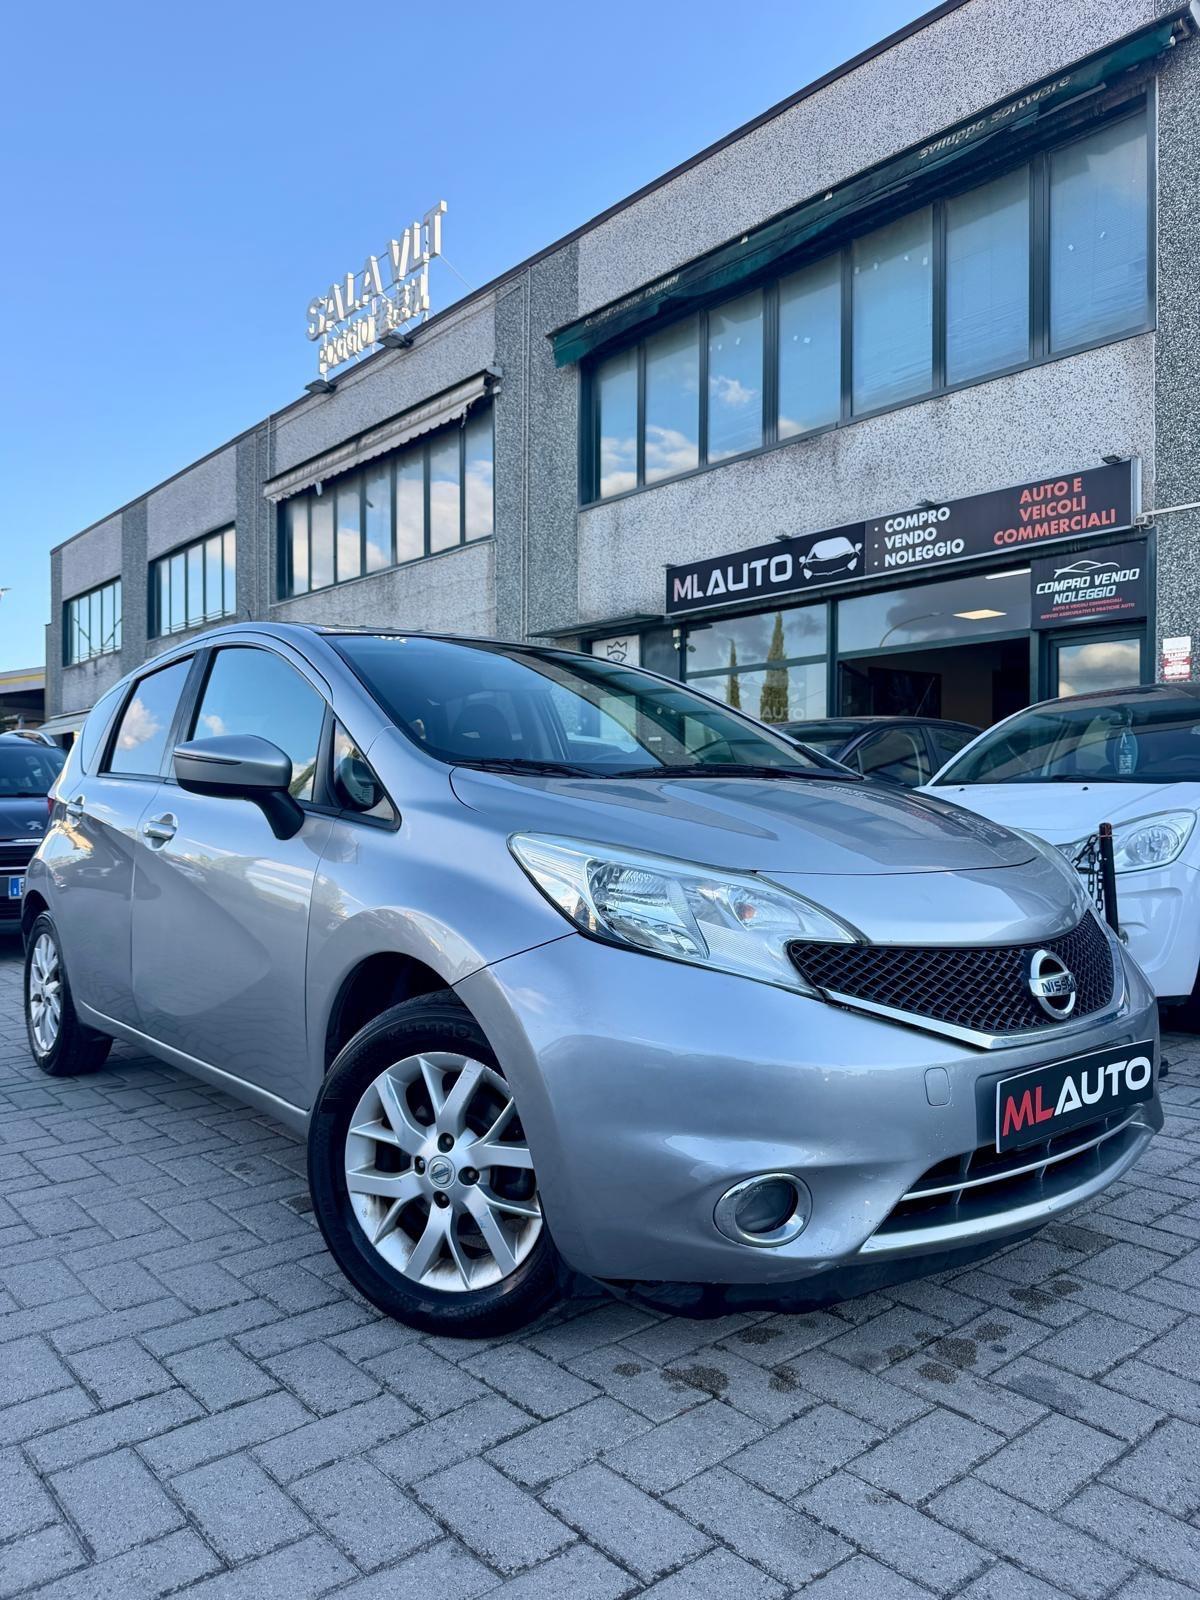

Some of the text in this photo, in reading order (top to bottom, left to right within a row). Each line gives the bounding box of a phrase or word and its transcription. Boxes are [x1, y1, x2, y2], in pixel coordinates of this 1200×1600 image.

[990, 75, 1073, 124] Software
[306, 255, 383, 341] SALA
[1019, 477, 1082, 504] AUTO E
[884, 506, 951, 533] COMPRO
[1019, 495, 1086, 522] VEICOLI
[884, 527, 937, 550] VENDO
[993, 508, 1116, 546] COMMERCIALI
[884, 538, 965, 567] NOLEGGIO
[1035, 567, 1140, 595] COMPRO VENDO
[1053, 585, 1117, 605] NOLEGGIO
